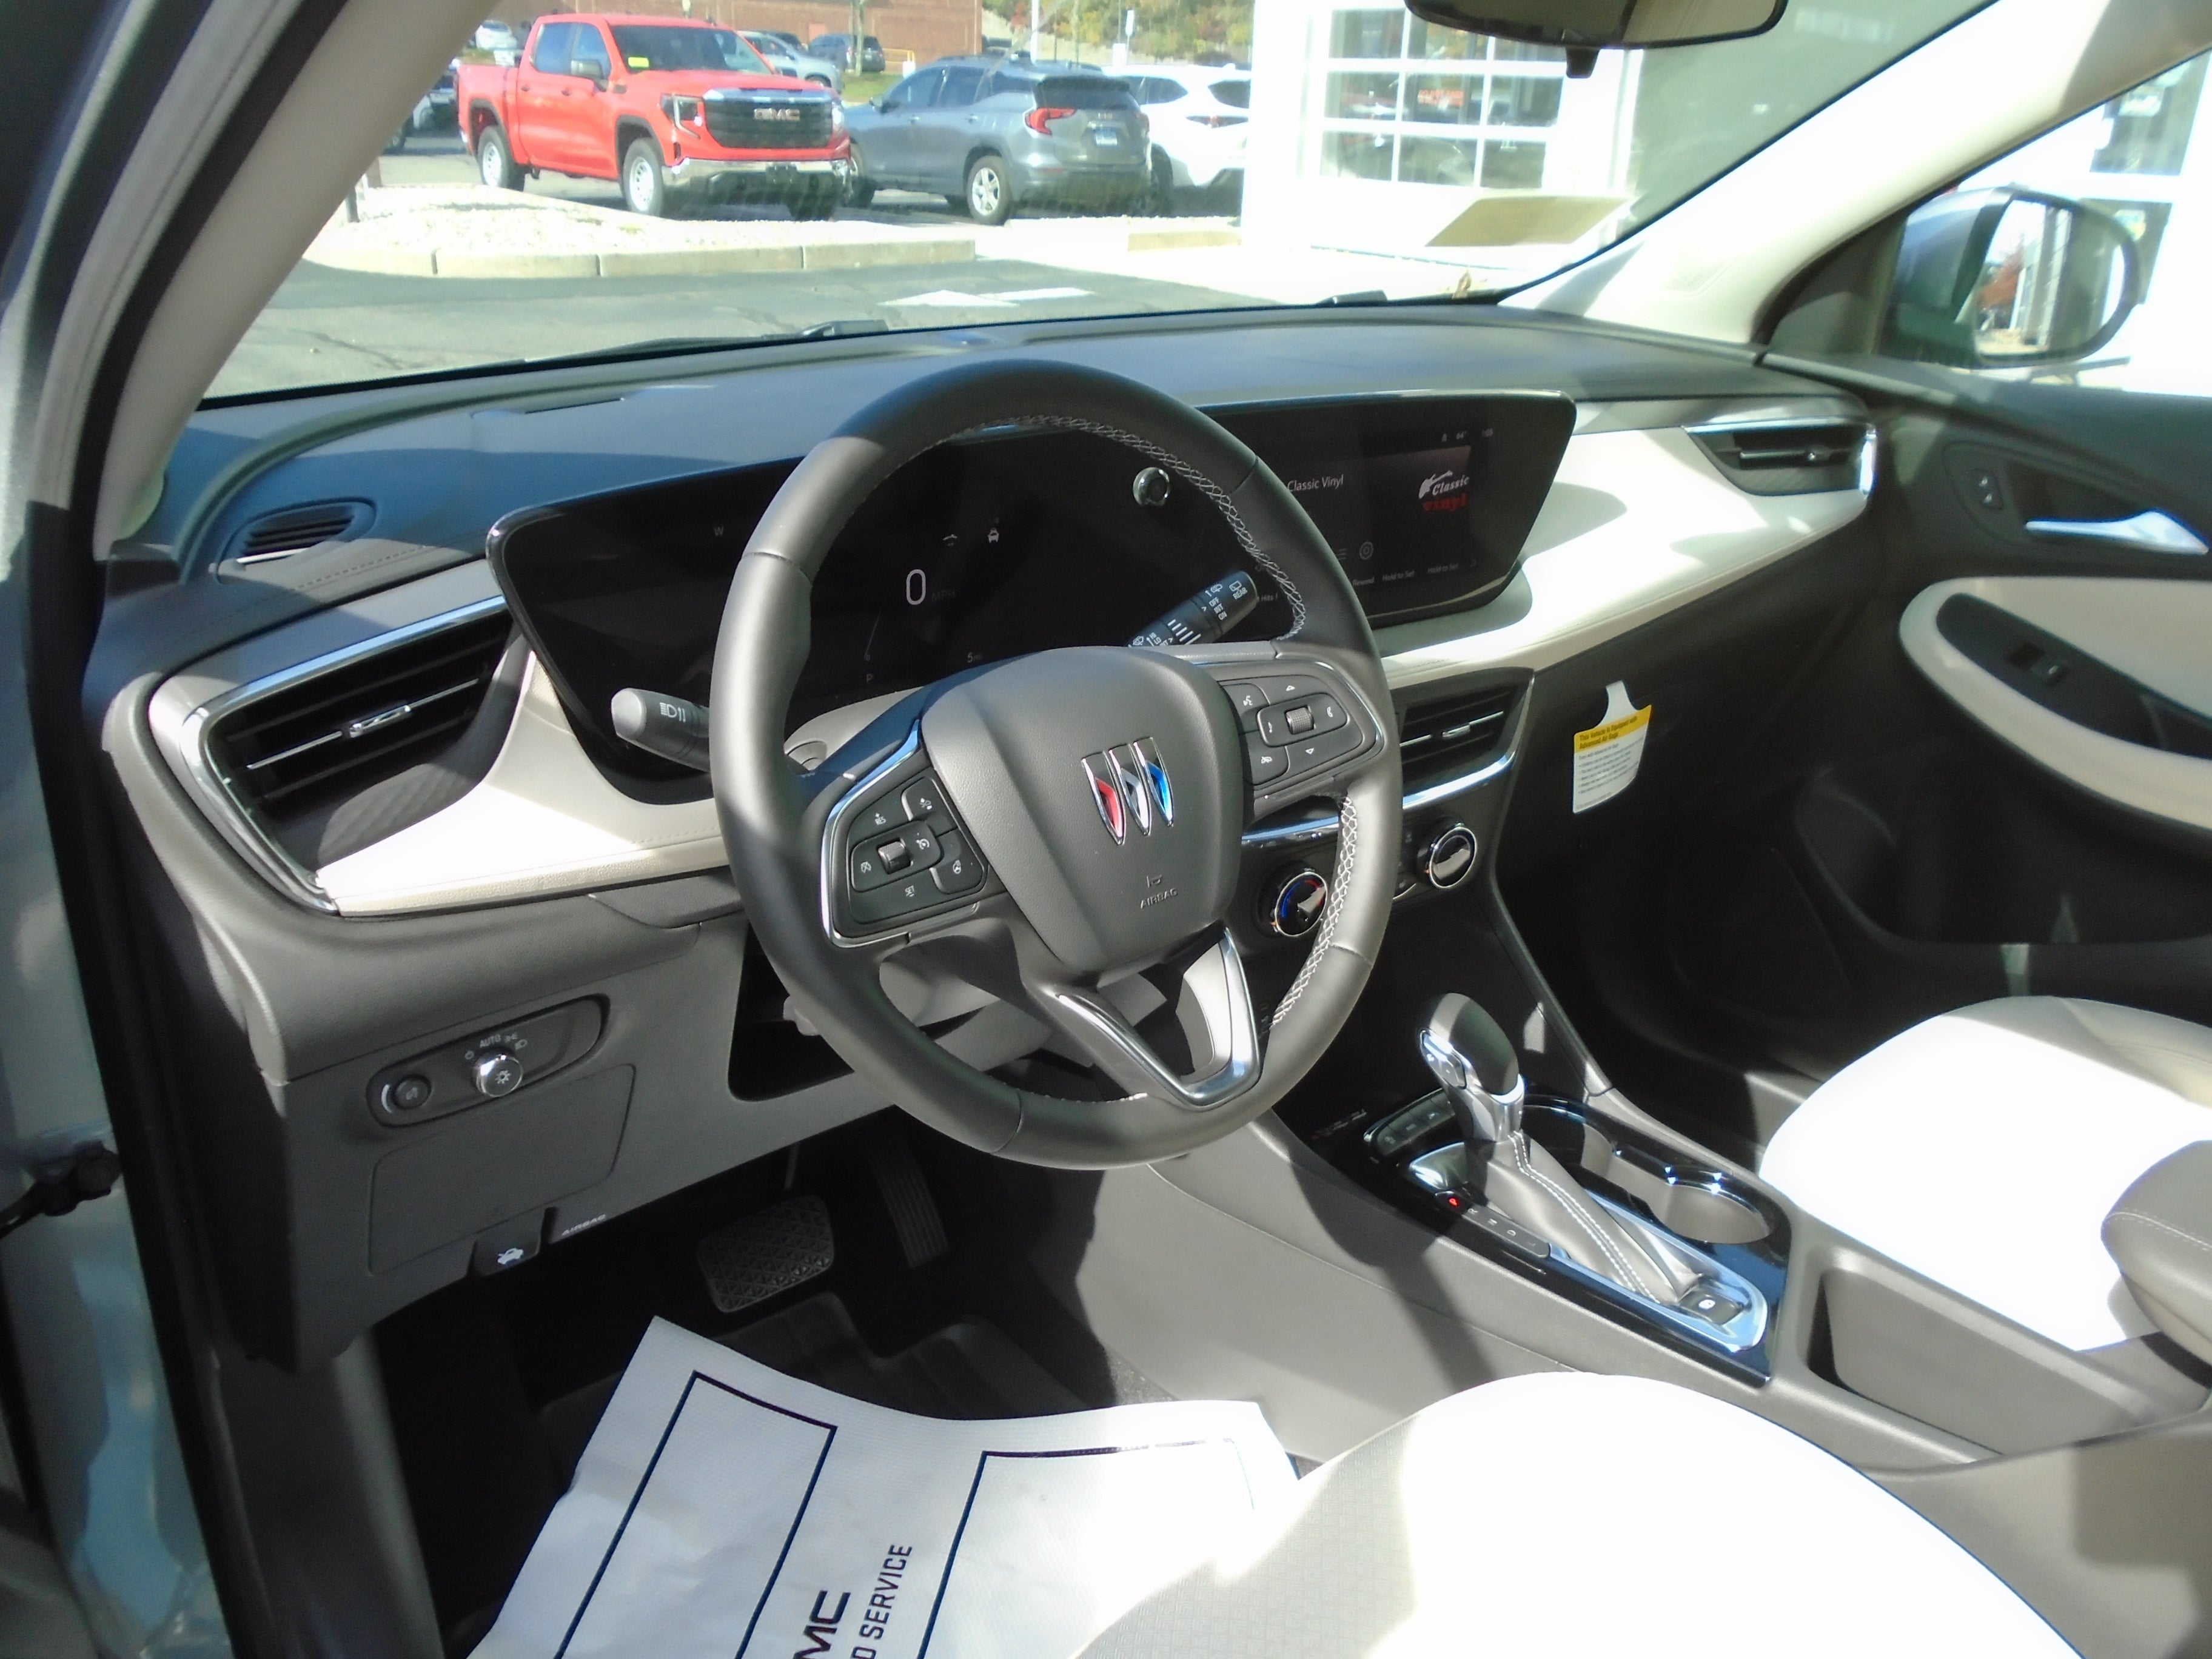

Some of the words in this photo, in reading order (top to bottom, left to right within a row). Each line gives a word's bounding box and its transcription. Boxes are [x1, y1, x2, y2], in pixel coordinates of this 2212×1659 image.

[754, 108, 800, 120] GMC
[1287, 478, 1319, 492] Classic
[1322, 474, 1344, 489] Vinyl
[1432, 474, 1470, 496] Classic
[1233, 587, 1248, 600] REAR
[1208, 597, 1219, 607] OFF
[1213, 603, 1224, 614] INT
[1218, 611, 1227, 620] ON
[1579, 733, 1589, 742] This
[1140, 888, 1178, 909] AIRBAG
[480, 1034, 501, 1048] AUTO
[1449, 1197, 1458, 1206] P
[561, 1214, 606, 1236] AIRBAG
[859, 1544, 913, 1640] SERVICE
